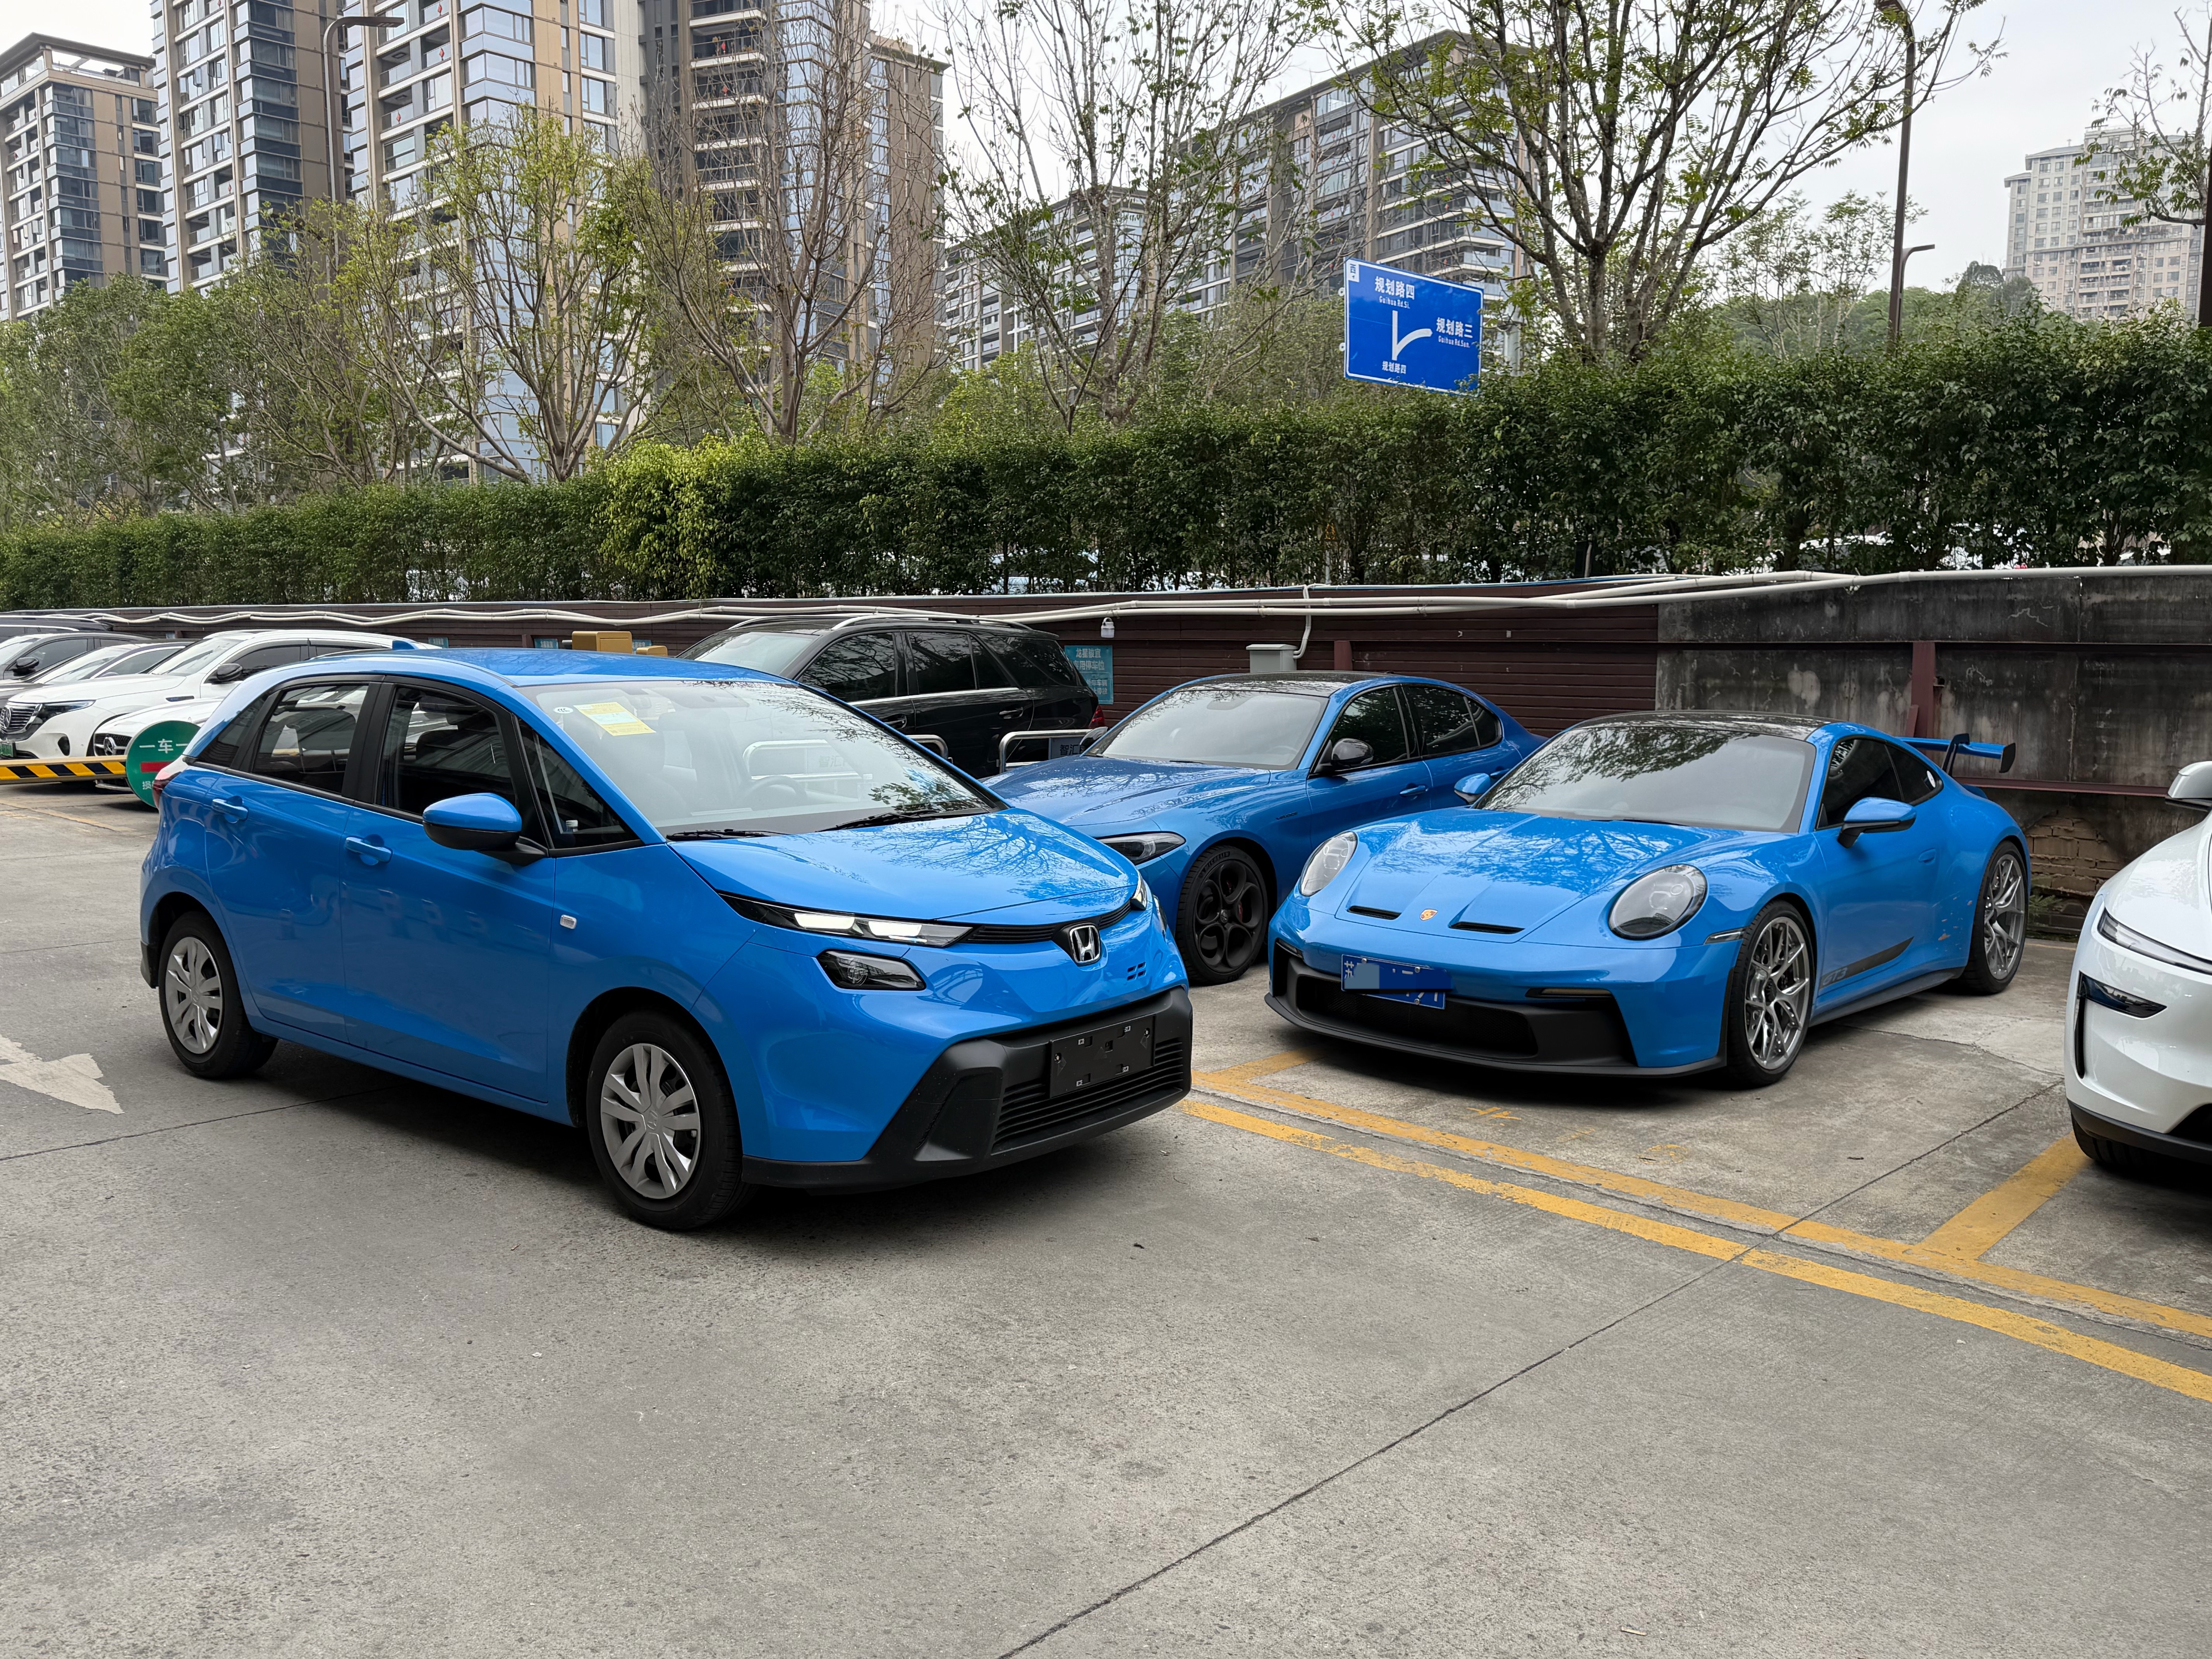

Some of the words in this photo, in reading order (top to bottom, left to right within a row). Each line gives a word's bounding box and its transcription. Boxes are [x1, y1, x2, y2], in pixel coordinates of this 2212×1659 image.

[1374, 276, 1415, 300] 规划路四
[1379, 295, 1396, 306] Guihua
[1436, 317, 1473, 338] 规划路三
[1438, 335, 1454, 345] Guihua
[1382, 361, 1407, 374] 规划路四
[1073, 660, 1104, 670] 专用停车位
[139, 738, 189, 754] 一车一
[1060, 744, 1081, 756] 智汇
[819, 755, 845, 768] 智汇
[1822, 967, 1848, 986] GT3
